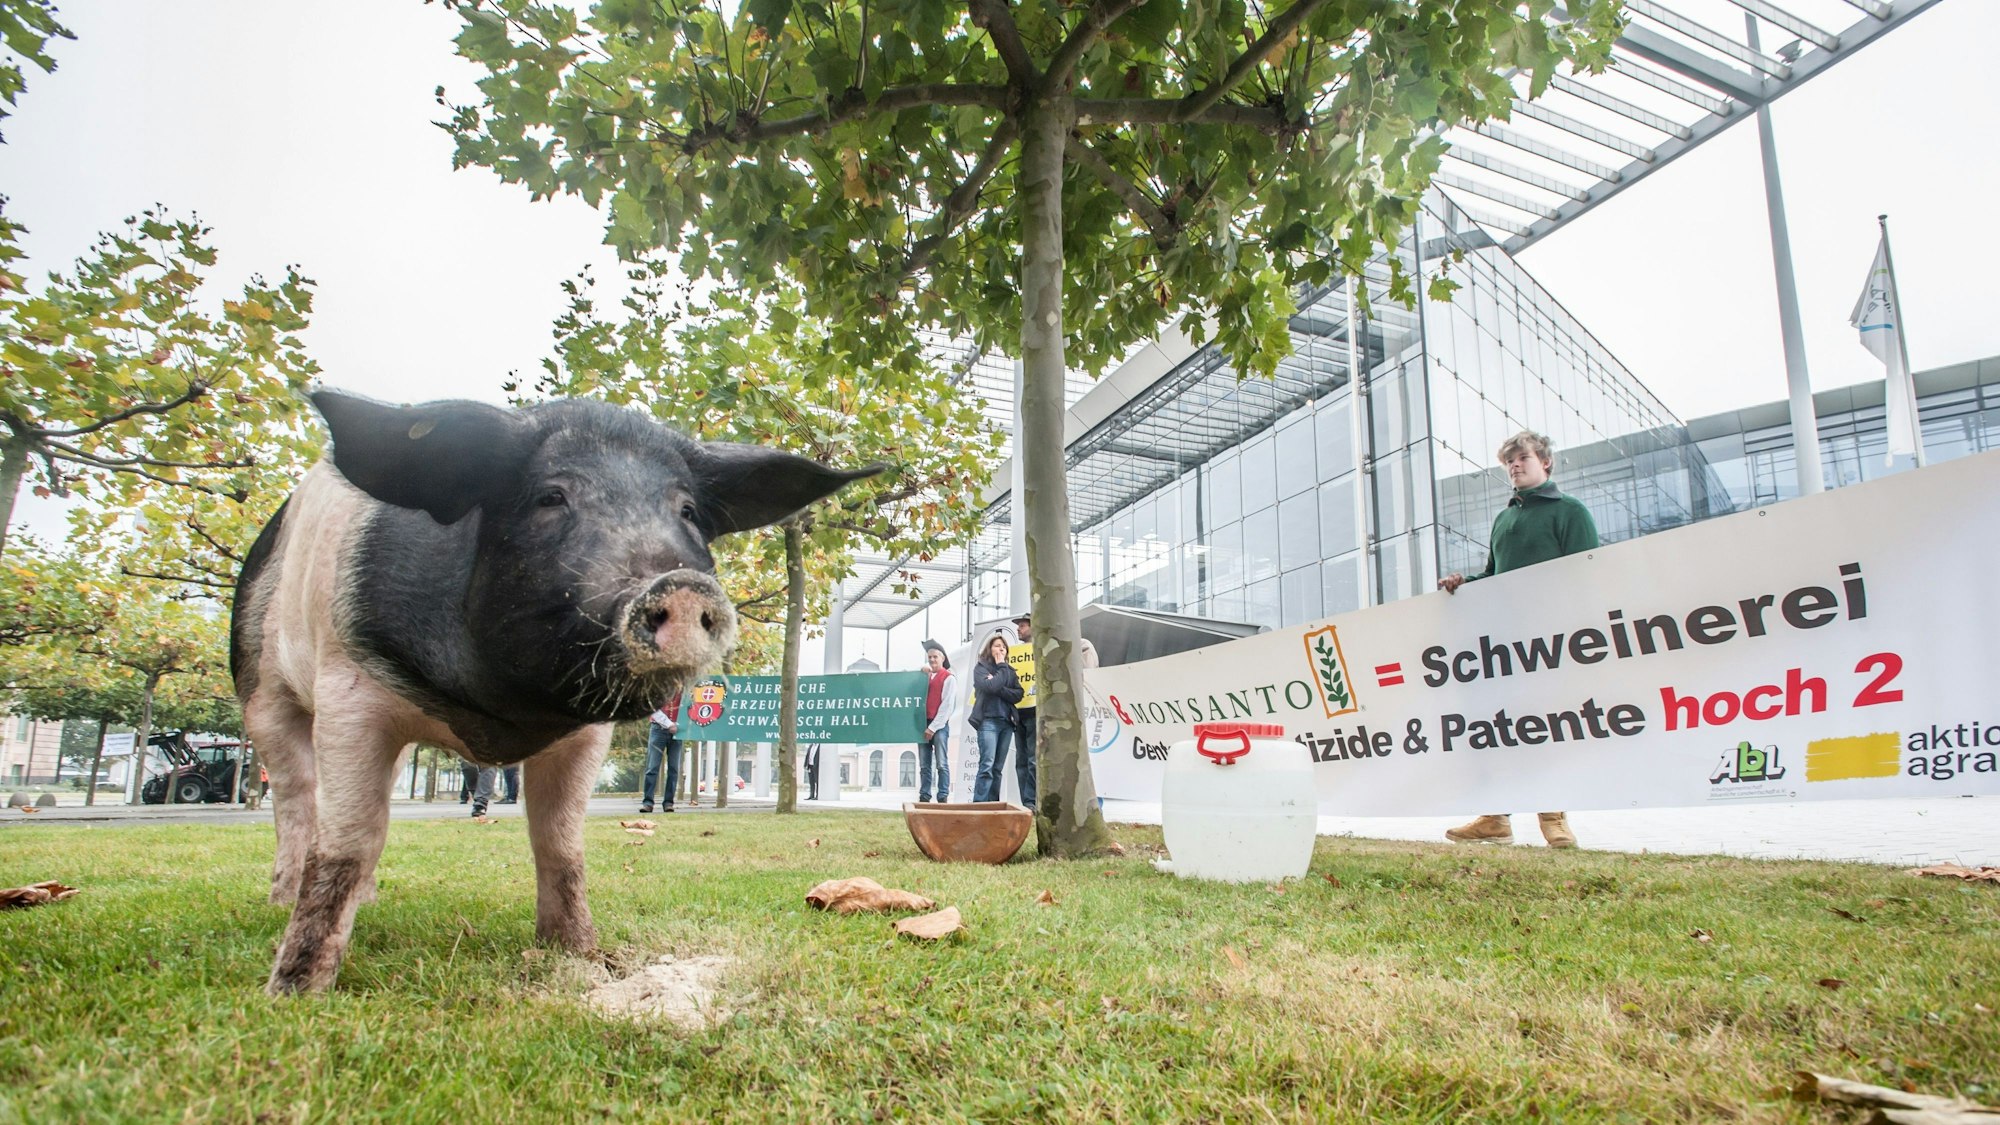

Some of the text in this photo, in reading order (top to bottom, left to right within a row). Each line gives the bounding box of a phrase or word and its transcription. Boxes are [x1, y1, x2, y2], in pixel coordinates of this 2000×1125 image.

[1109, 695, 1134, 726] &
[1130, 680, 1313, 724] MONSANTO
[1421, 562, 1868, 688] Schweinerei
[733, 682, 827, 694] BÄUERCHE
[731, 696, 922, 710] ERZEURGEMEINSCHAFT
[1132, 735, 1172, 761] Gent
[1402, 718, 1429, 755] &
[1441, 698, 1646, 752] Patente
[1660, 668, 1828, 732] hoch
[1852, 652, 1904, 708] 2
[728, 714, 869, 726] SCHWÄSCH HALL
[1709, 741, 1786, 784] AbL
